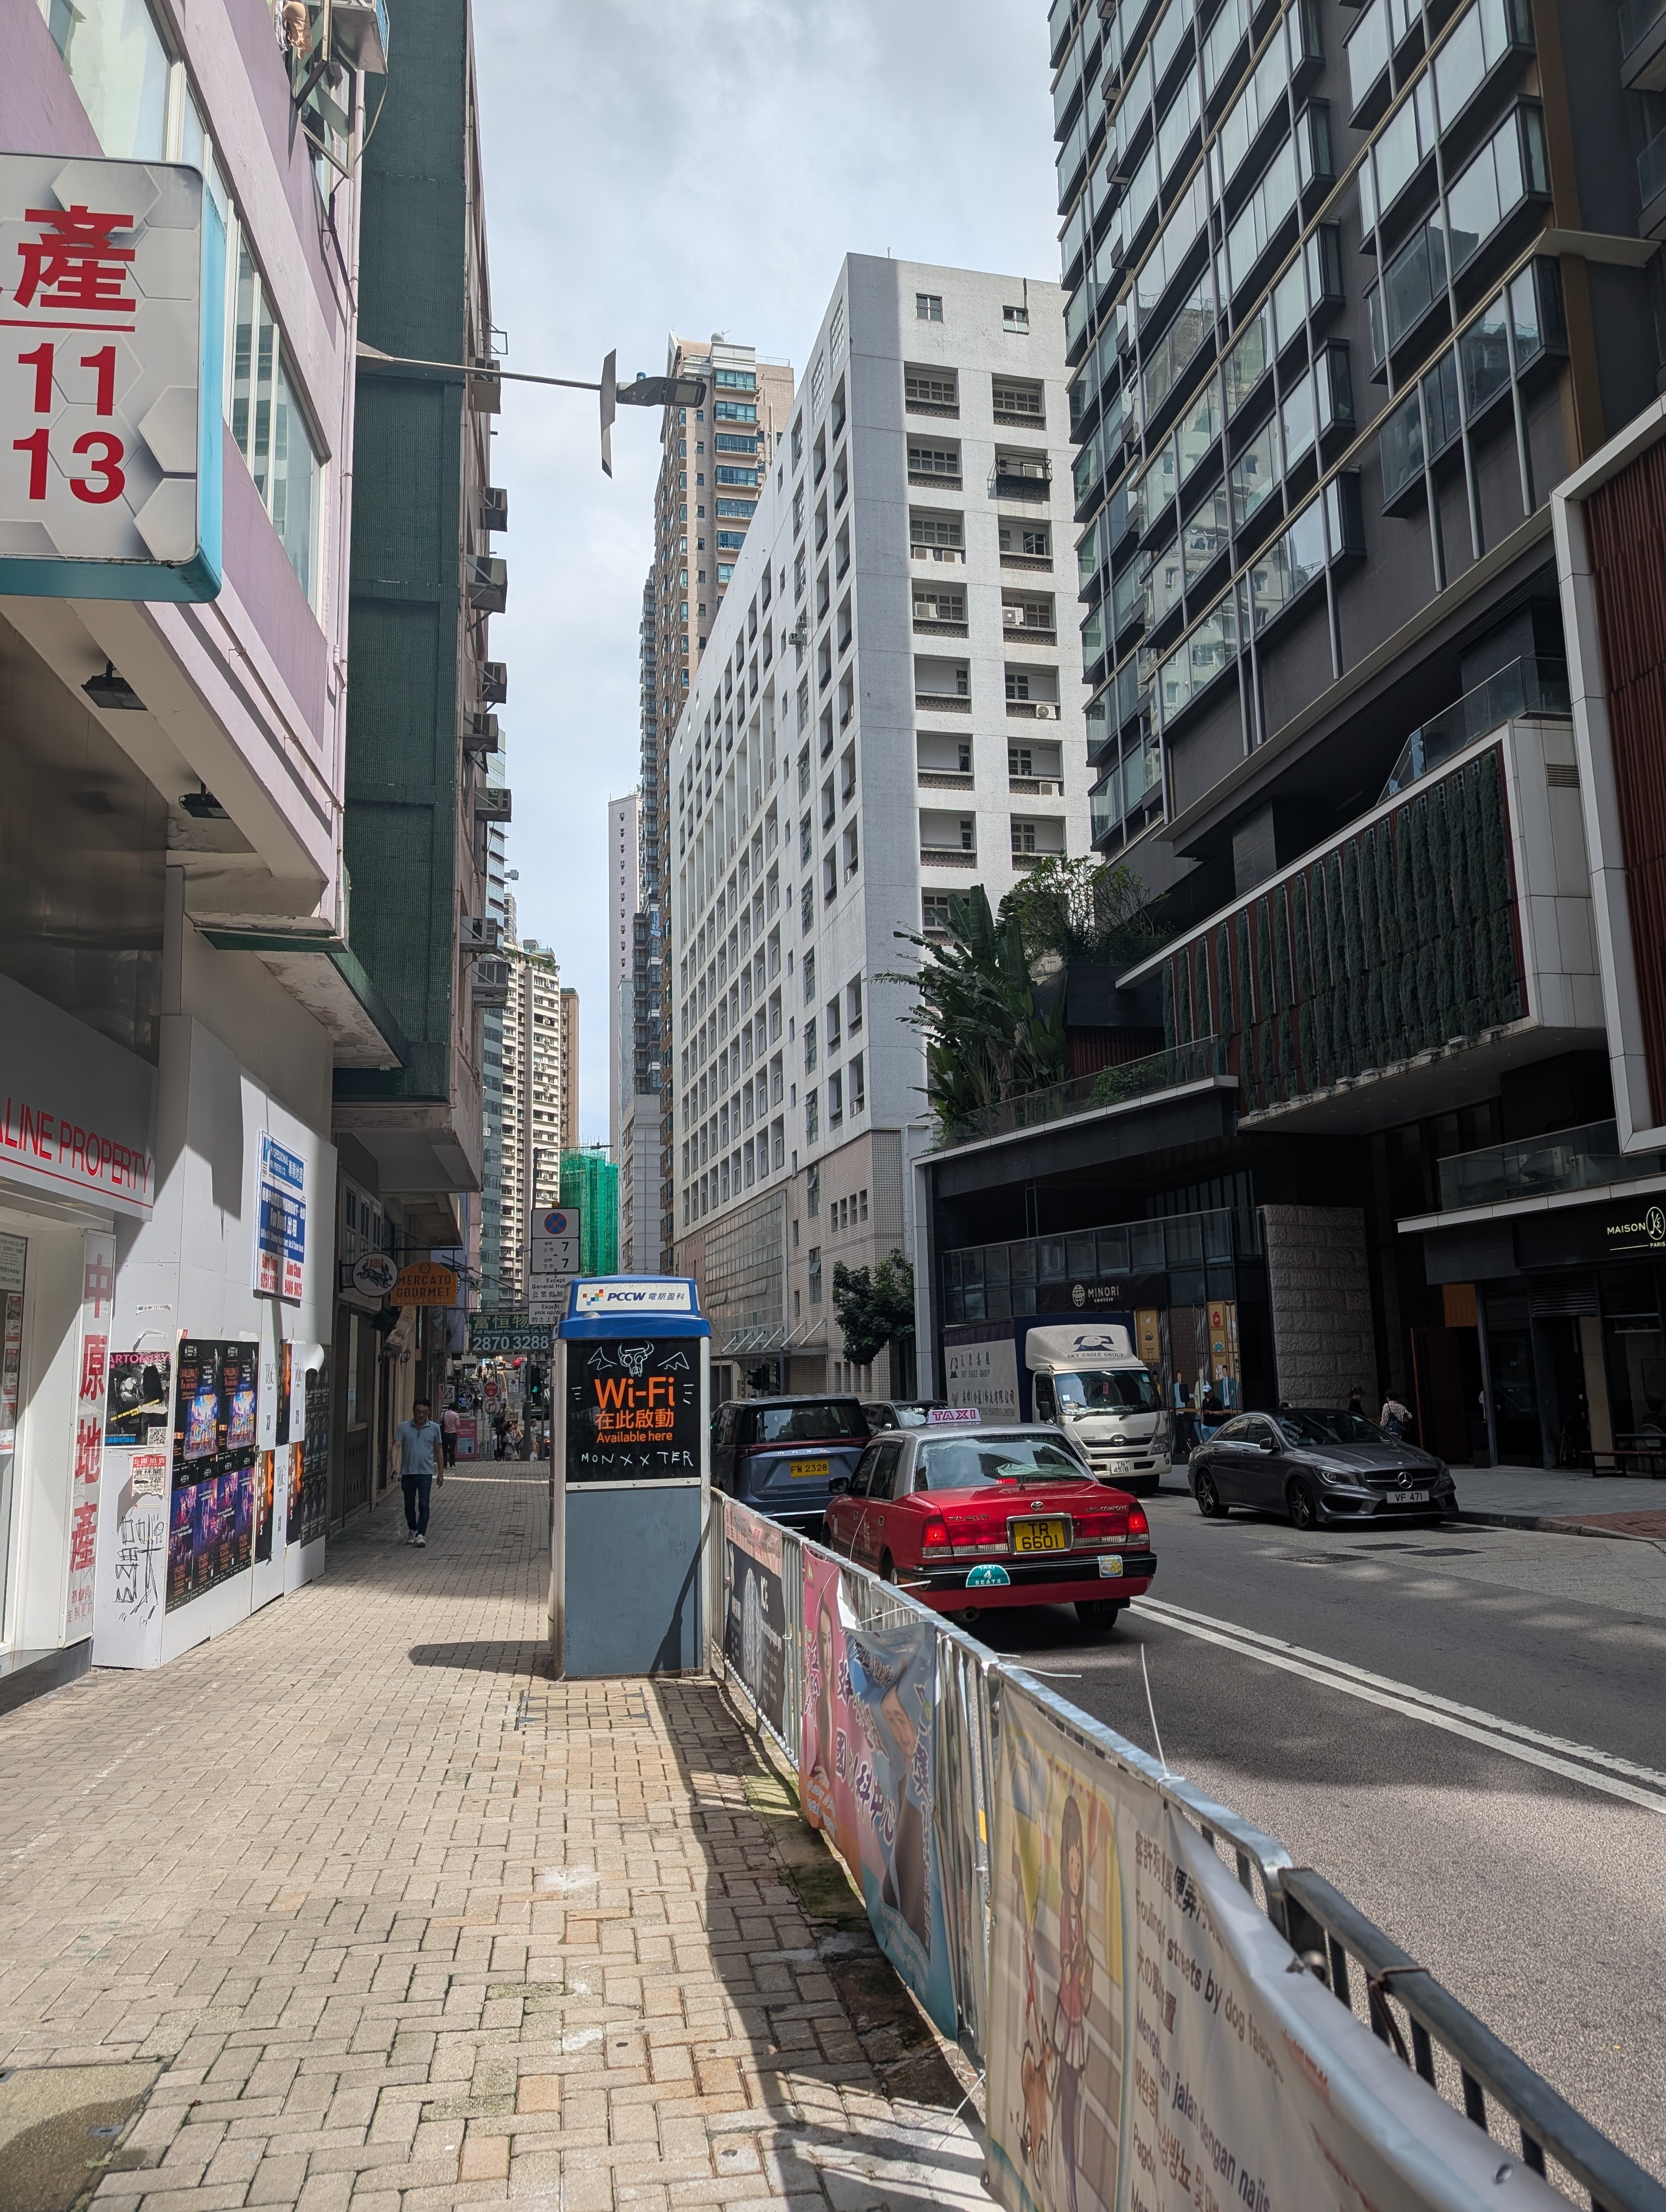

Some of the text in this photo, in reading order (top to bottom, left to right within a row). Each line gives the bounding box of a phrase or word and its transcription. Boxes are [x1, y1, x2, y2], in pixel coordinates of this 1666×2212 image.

[13, 205, 136, 312] 產
[18, 343, 116, 416] 11
[12, 428, 126, 504] 13
[0, 1097, 151, 1193] LINE PROPERTY
[1607, 1223, 1646, 1234] MAISON
[561, 1242, 569, 1252] 7
[561, 1258, 569, 1268] 7
[398, 1275, 451, 1285] MERCATO
[397, 1287, 451, 1297] GOURMET
[607, 1293, 646, 1301] PCCW
[1088, 1286, 1119, 1298] MINORI
[473, 1315, 549, 1329] 富恒物
[472, 1335, 549, 1351] 2870 3288
[979, 1369, 990, 1378] GROUP
[594, 1377, 675, 1409] Wi-Fi
[70, 1253, 112, 1573] 中原地產
[932, 1410, 976, 1420] TAXI
[597, 1430, 672, 1443] Available here
[791, 1463, 828, 1474] FW 2328
[1410, 1493, 1422, 1501] 471
[1028, 1522, 1049, 1535] TR
[1022, 1535, 1059, 1550] 6601
[983, 1571, 992, 1579] 4
[1167, 1938, 1202, 1992] streets
[1205, 1969, 1222, 2014] by
[1225, 1990, 1245, 2042] dog
[1172, 2072, 1199, 2130] jalan
[1200, 2108, 1236, 2186] dengan
